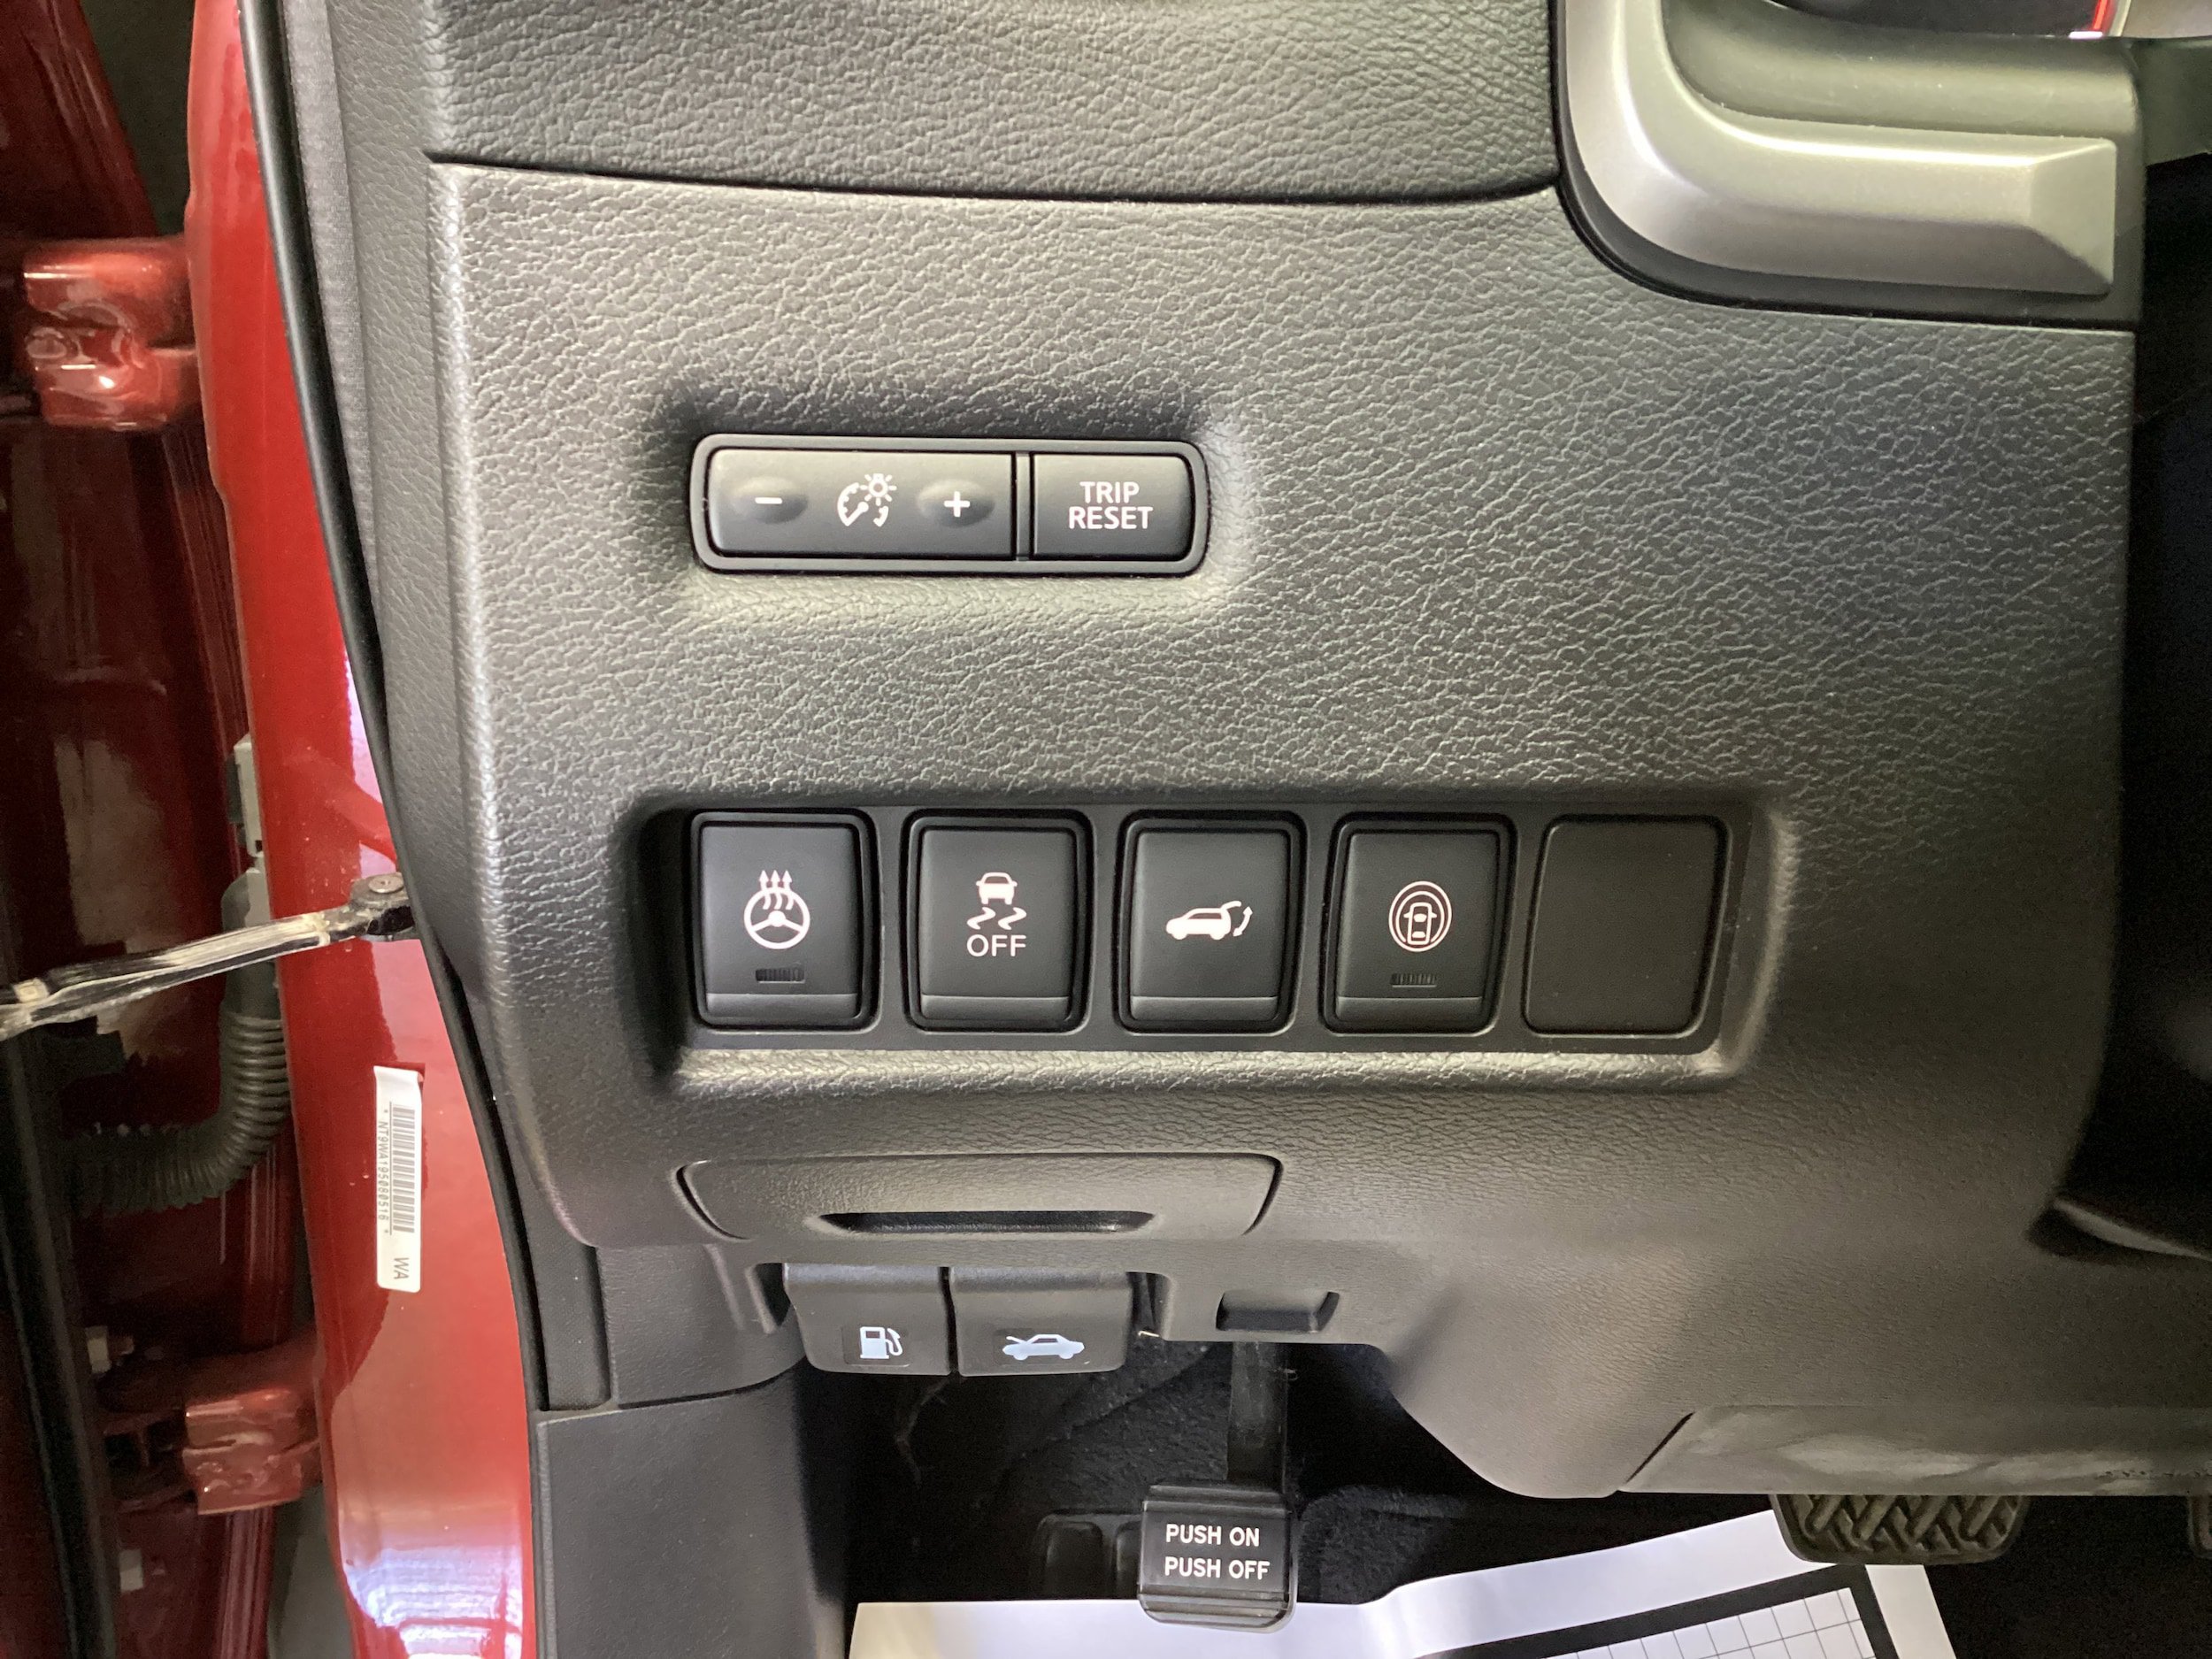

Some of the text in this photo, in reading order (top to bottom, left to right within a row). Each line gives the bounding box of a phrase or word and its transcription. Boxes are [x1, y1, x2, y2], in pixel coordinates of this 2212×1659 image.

[1079, 481, 1140, 503] TRIP
[1068, 506, 1153, 529] RESET
[966, 933, 1027, 957] OFF
[393, 1256, 410, 1280] WA
[1165, 1523, 1260, 1547] PUSH ON
[1164, 1555, 1271, 1580] PUSH OFF
